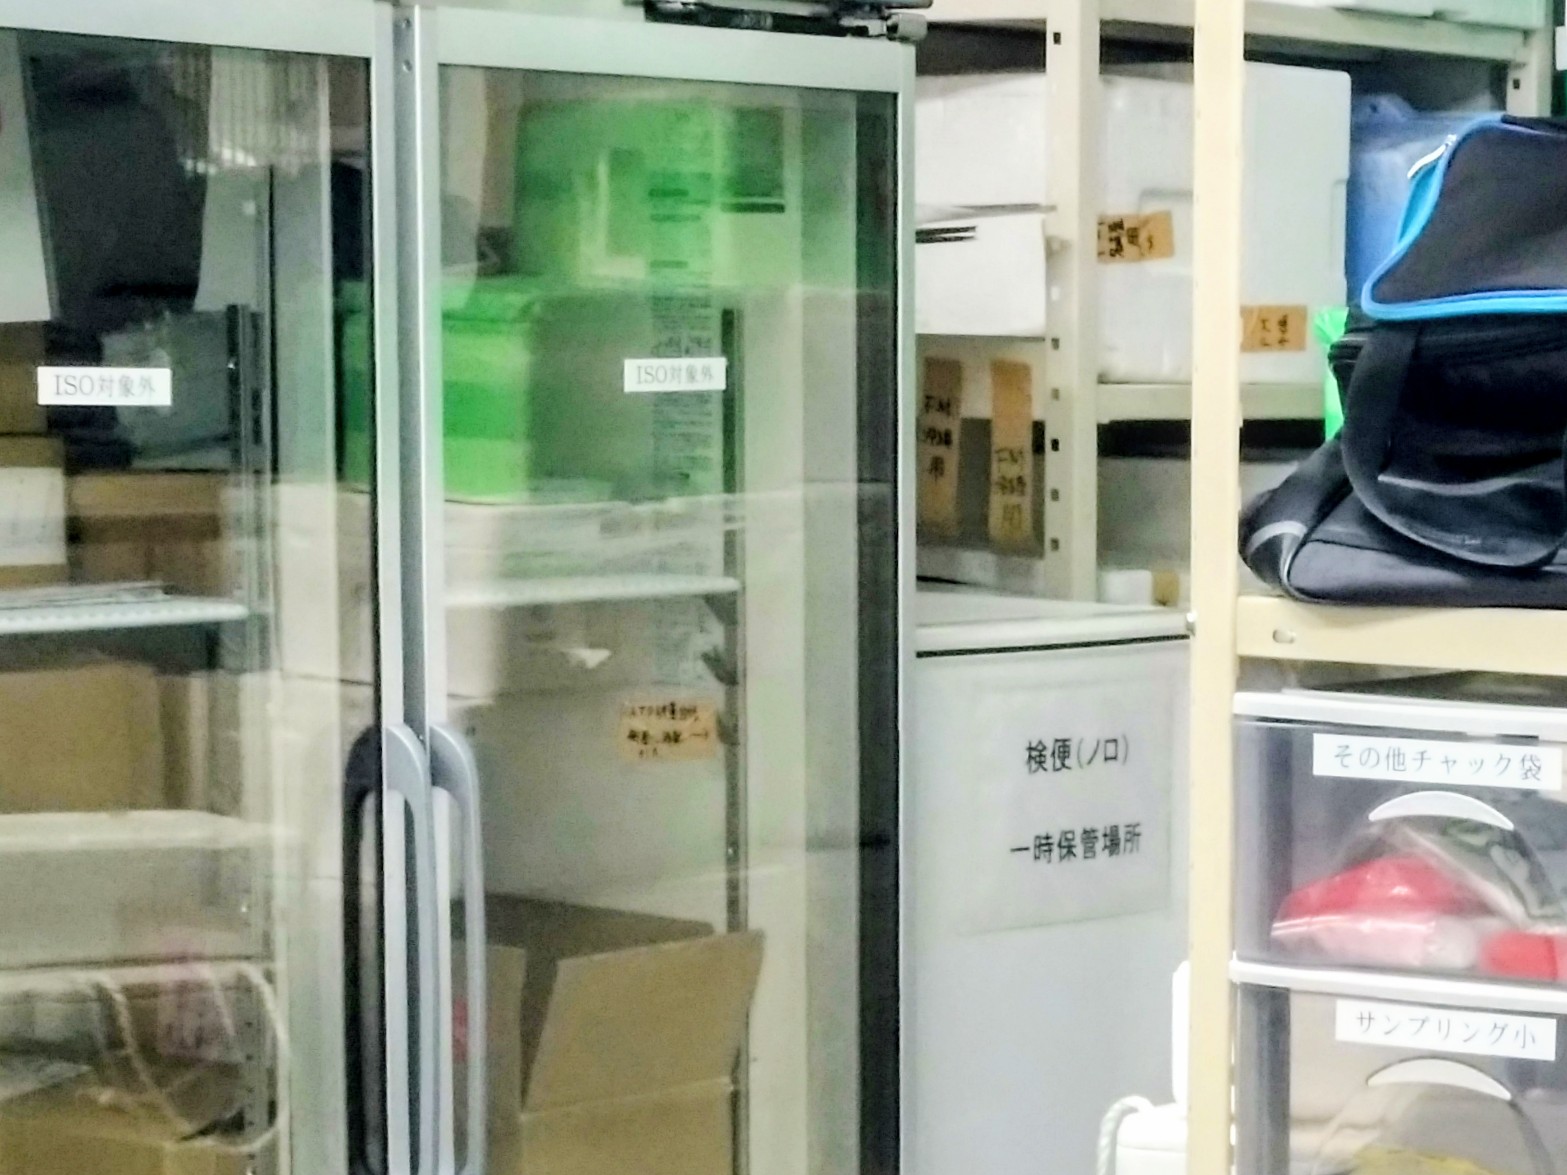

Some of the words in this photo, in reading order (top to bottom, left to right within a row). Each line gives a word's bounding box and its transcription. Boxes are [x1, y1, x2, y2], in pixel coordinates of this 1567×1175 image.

[54, 373, 156, 398] ISO対象外
[636, 364, 714, 386] ISO対象外
[1334, 743, 1543, 782] その他チャック袋
[1009, 821, 1143, 865] 一時保管場所
[1355, 1010, 1537, 1050] サンプリング小
